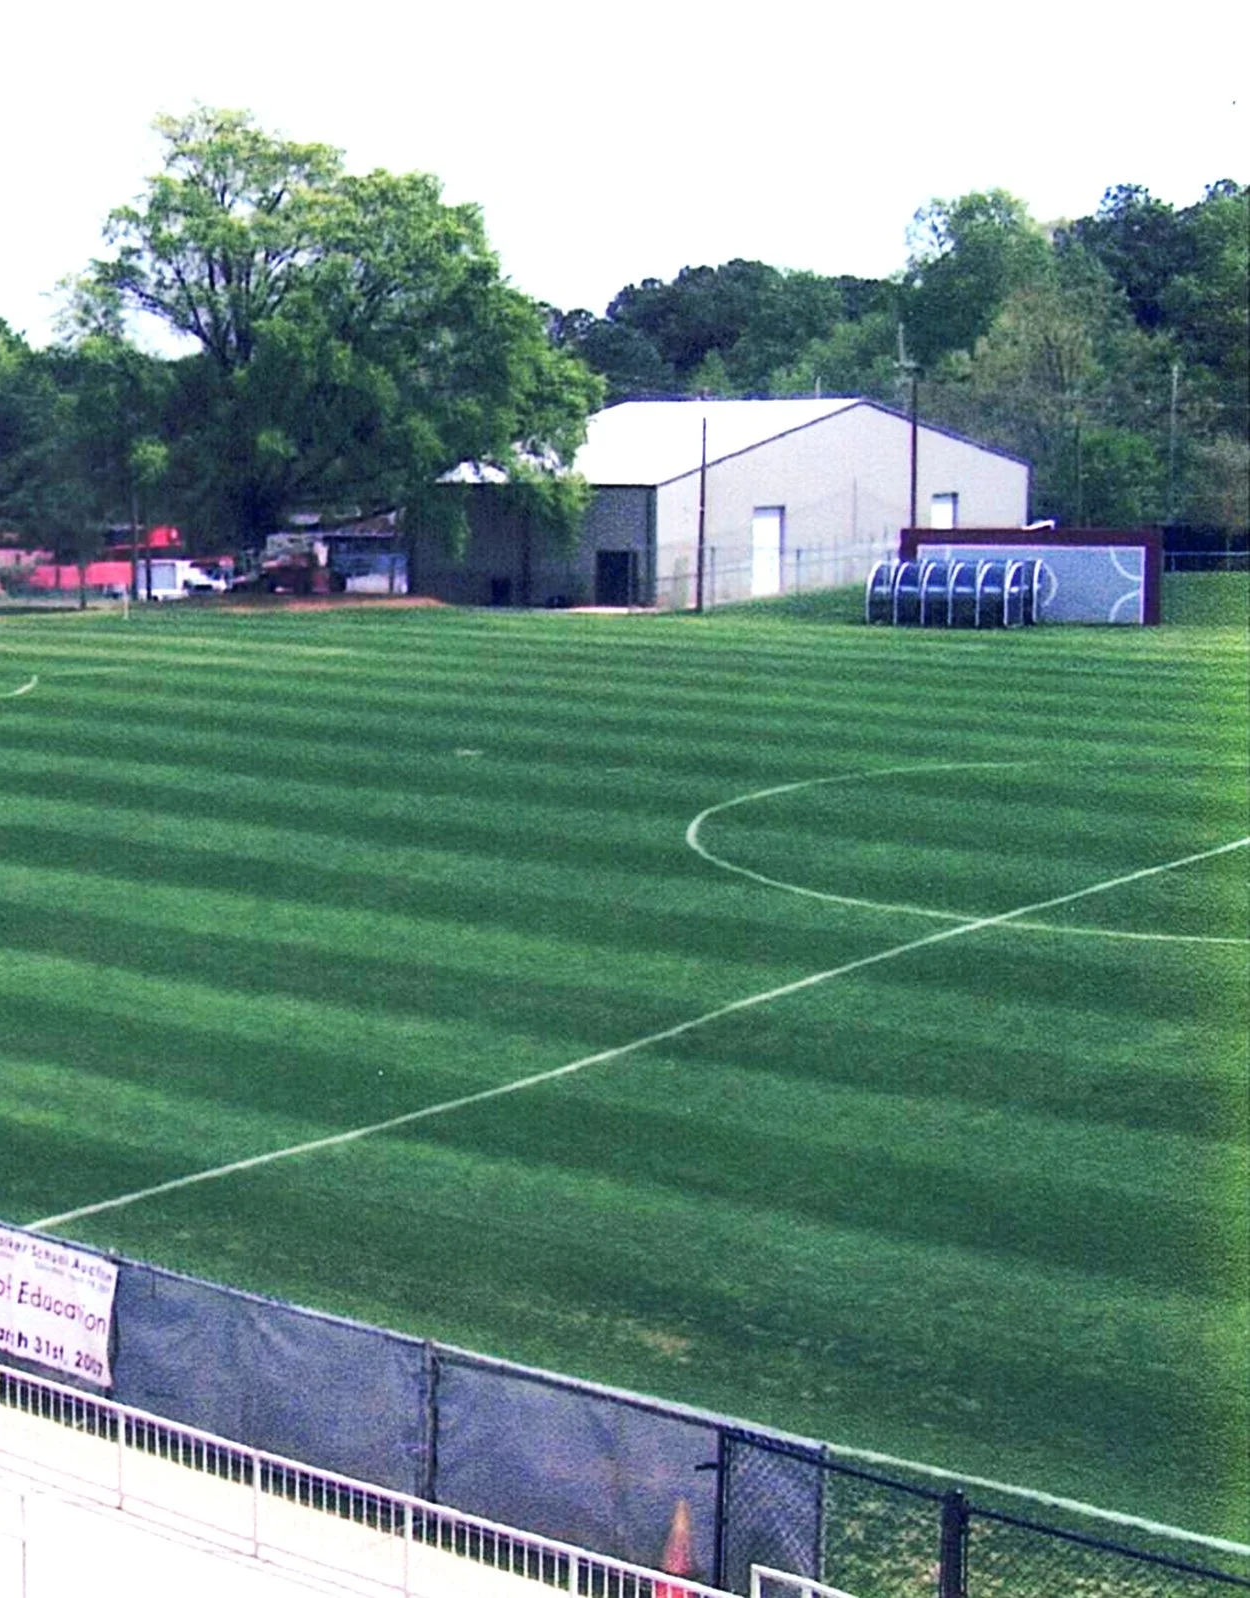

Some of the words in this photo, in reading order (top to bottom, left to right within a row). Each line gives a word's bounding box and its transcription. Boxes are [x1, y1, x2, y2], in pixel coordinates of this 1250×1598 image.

[31, 1244, 69, 1266] School
[71, 1257, 112, 1282] Auction
[17, 1280, 106, 1335] Education
